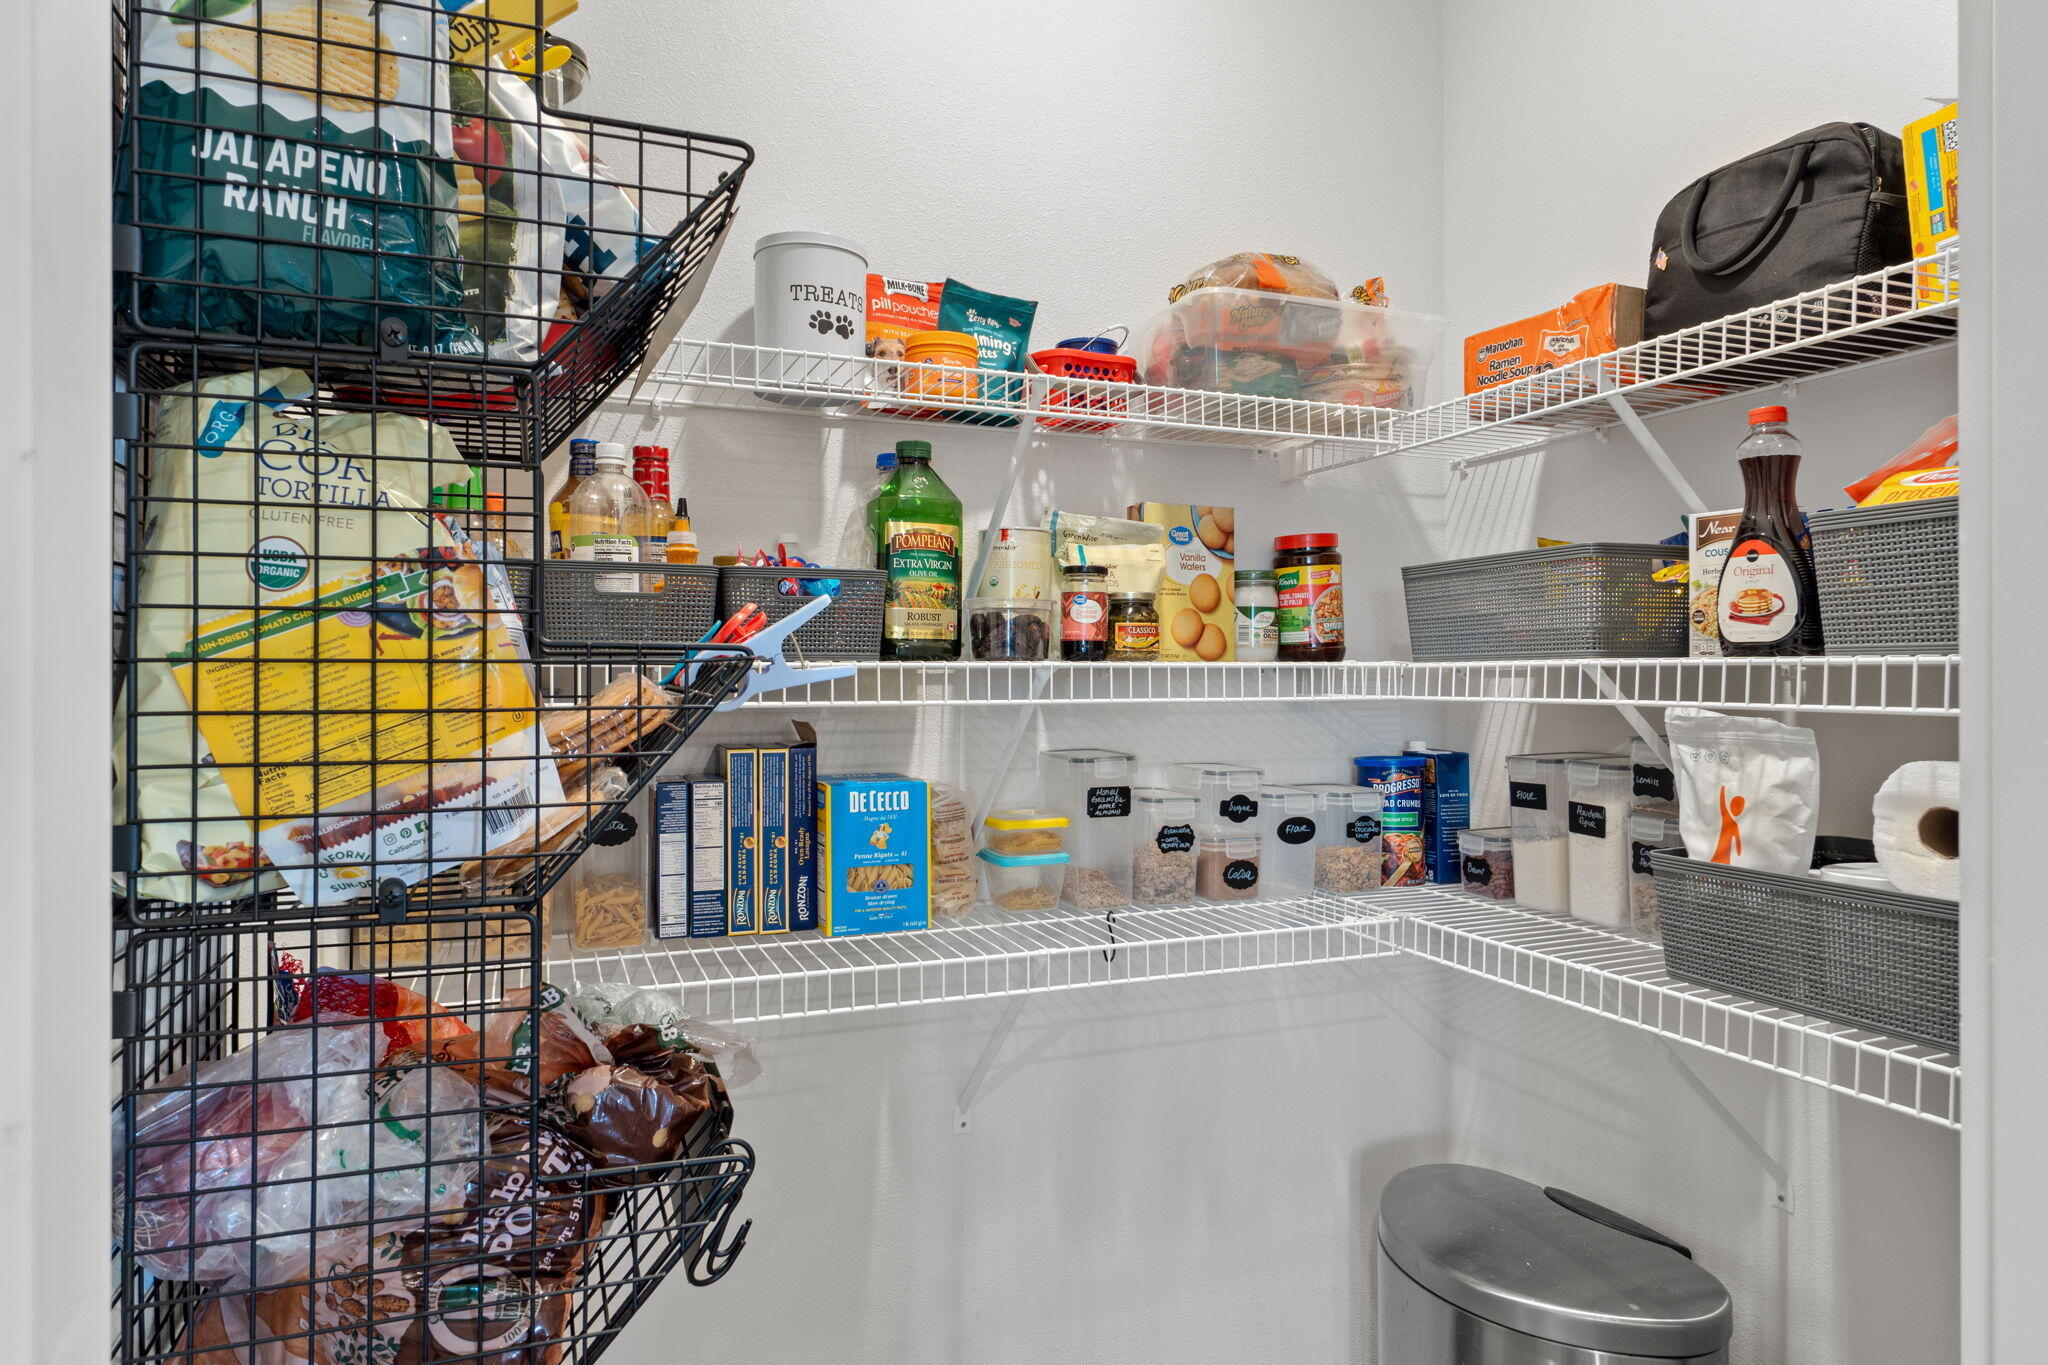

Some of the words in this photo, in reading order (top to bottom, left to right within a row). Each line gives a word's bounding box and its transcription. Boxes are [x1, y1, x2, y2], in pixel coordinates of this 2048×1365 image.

[224, 171, 348, 230] RANCH
[887, 279, 926, 297] MILK-BONE
[790, 284, 864, 314] TREATS
[1485, 338, 1524, 355] Maruchan
[1489, 356, 1521, 372] Ramen
[1477, 370, 1509, 387] Noodle
[1510, 364, 1533, 377] Soup
[249, 507, 312, 526] GLUTEN
[318, 514, 355, 531] FREE
[1171, 530, 1189, 539] Great
[1699, 520, 1736, 538] Near
[895, 534, 951, 550] POMPEIAN
[1180, 552, 1206, 562] Vanilla
[1704, 547, 1729, 557] COUS
[893, 557, 922, 569] EXTRA
[924, 558, 953, 571] VIRGIN
[1180, 562, 1206, 572] Wafers
[1733, 564, 1774, 578] Original
[1278, 577, 1298, 587] Knorr
[907, 611, 942, 622] ROBUST
[1128, 626, 1156, 634] CLASSICO
[1373, 778, 1420, 794] PROGRESSO
[850, 791, 867, 813] DE
[869, 790, 910, 812] CECCO
[1397, 799, 1421, 808] CRUMBS
[799, 875, 809, 921] RONZONI
[736, 889, 747, 925] RONZONI
[767, 889, 778, 925] RONZONI
